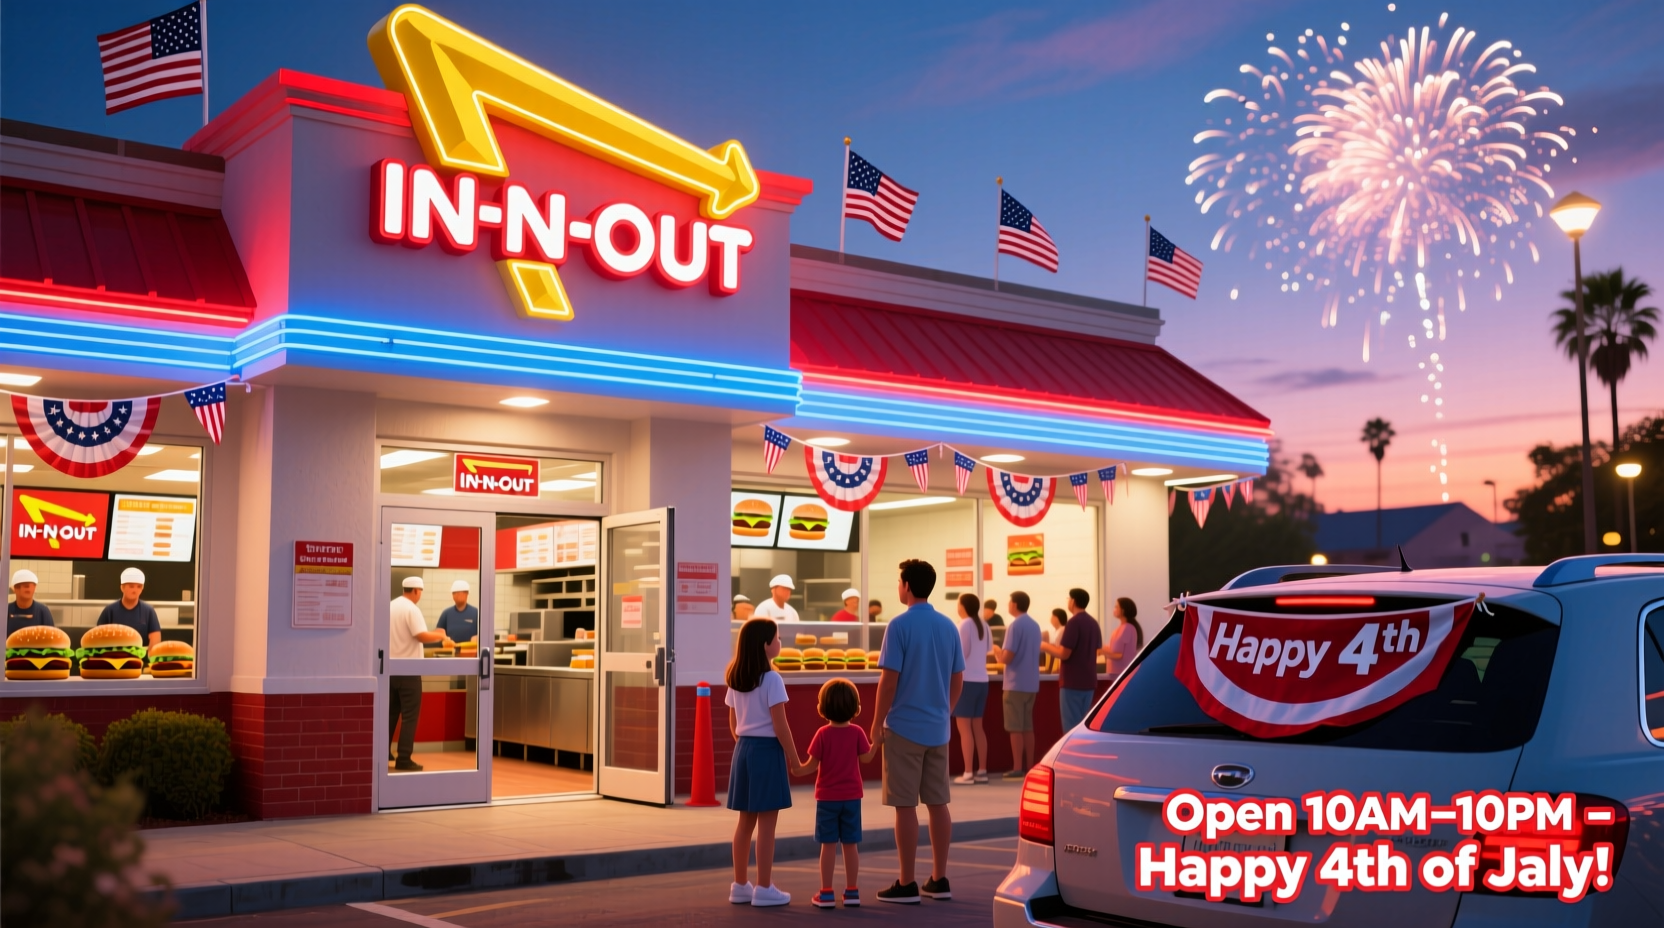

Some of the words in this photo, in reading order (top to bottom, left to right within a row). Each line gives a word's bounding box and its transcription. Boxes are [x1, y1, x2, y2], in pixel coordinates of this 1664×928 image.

[377, 160, 754, 292] IN-N-OUT
[460, 472, 535, 493] IN-N-OUT
[1209, 621, 1332, 679] Happy
[1338, 618, 1421, 676] 4th
